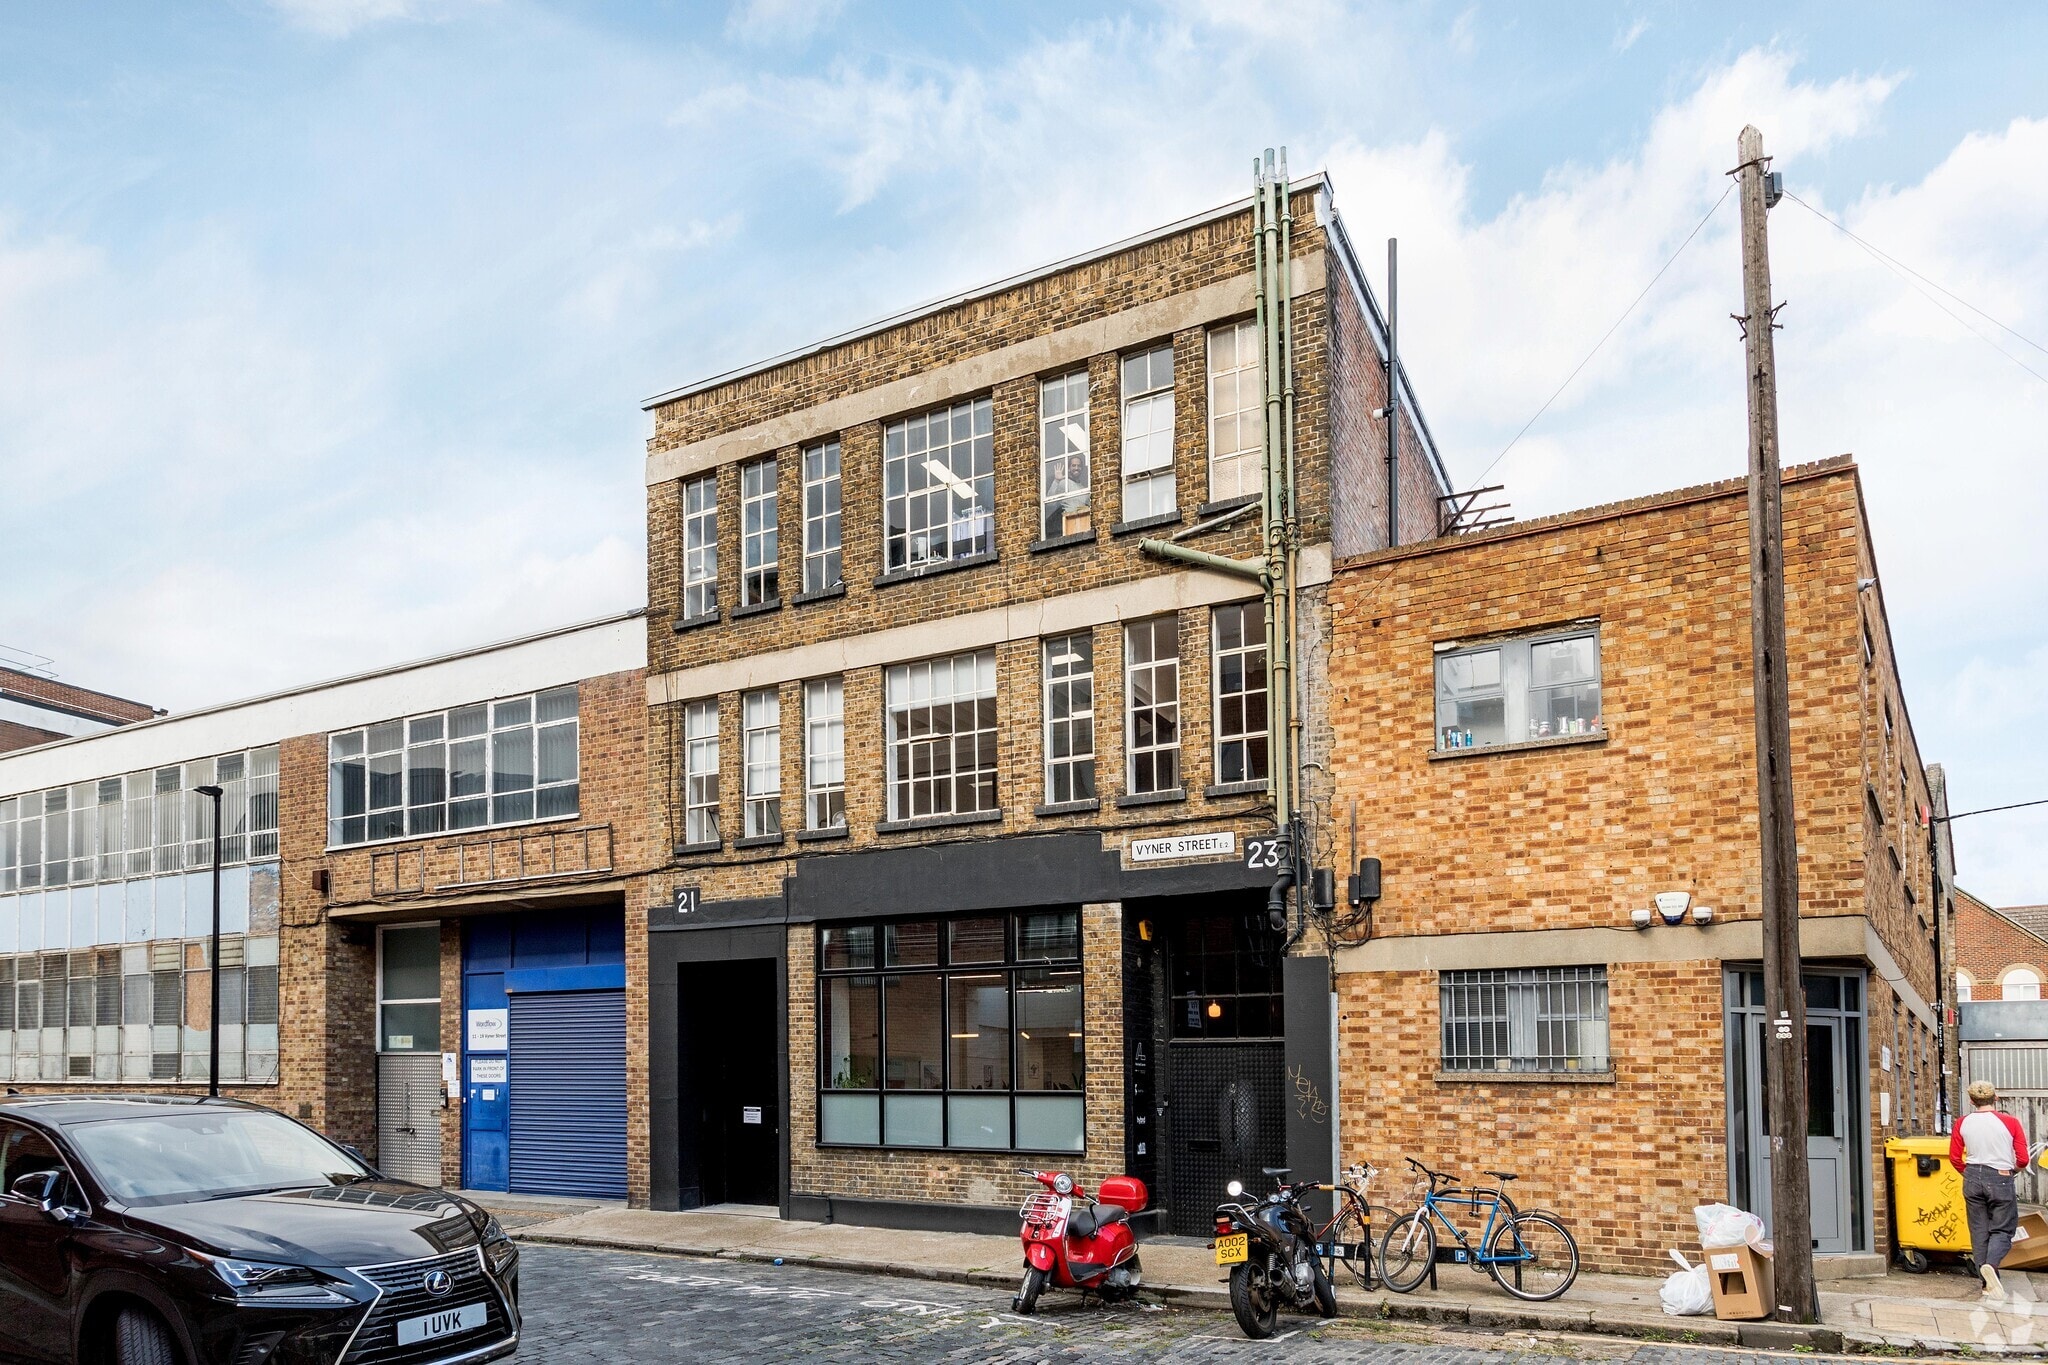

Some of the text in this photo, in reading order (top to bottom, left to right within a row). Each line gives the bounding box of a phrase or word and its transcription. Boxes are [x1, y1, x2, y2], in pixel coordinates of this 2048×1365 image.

[1136, 842, 1172, 856] VYNER
[1178, 838, 1219, 852] STREET
[1247, 840, 1279, 869] 23
[678, 891, 694, 913] 21
[1221, 1247, 1241, 1258] SGX
[432, 1311, 461, 1333] UVK
